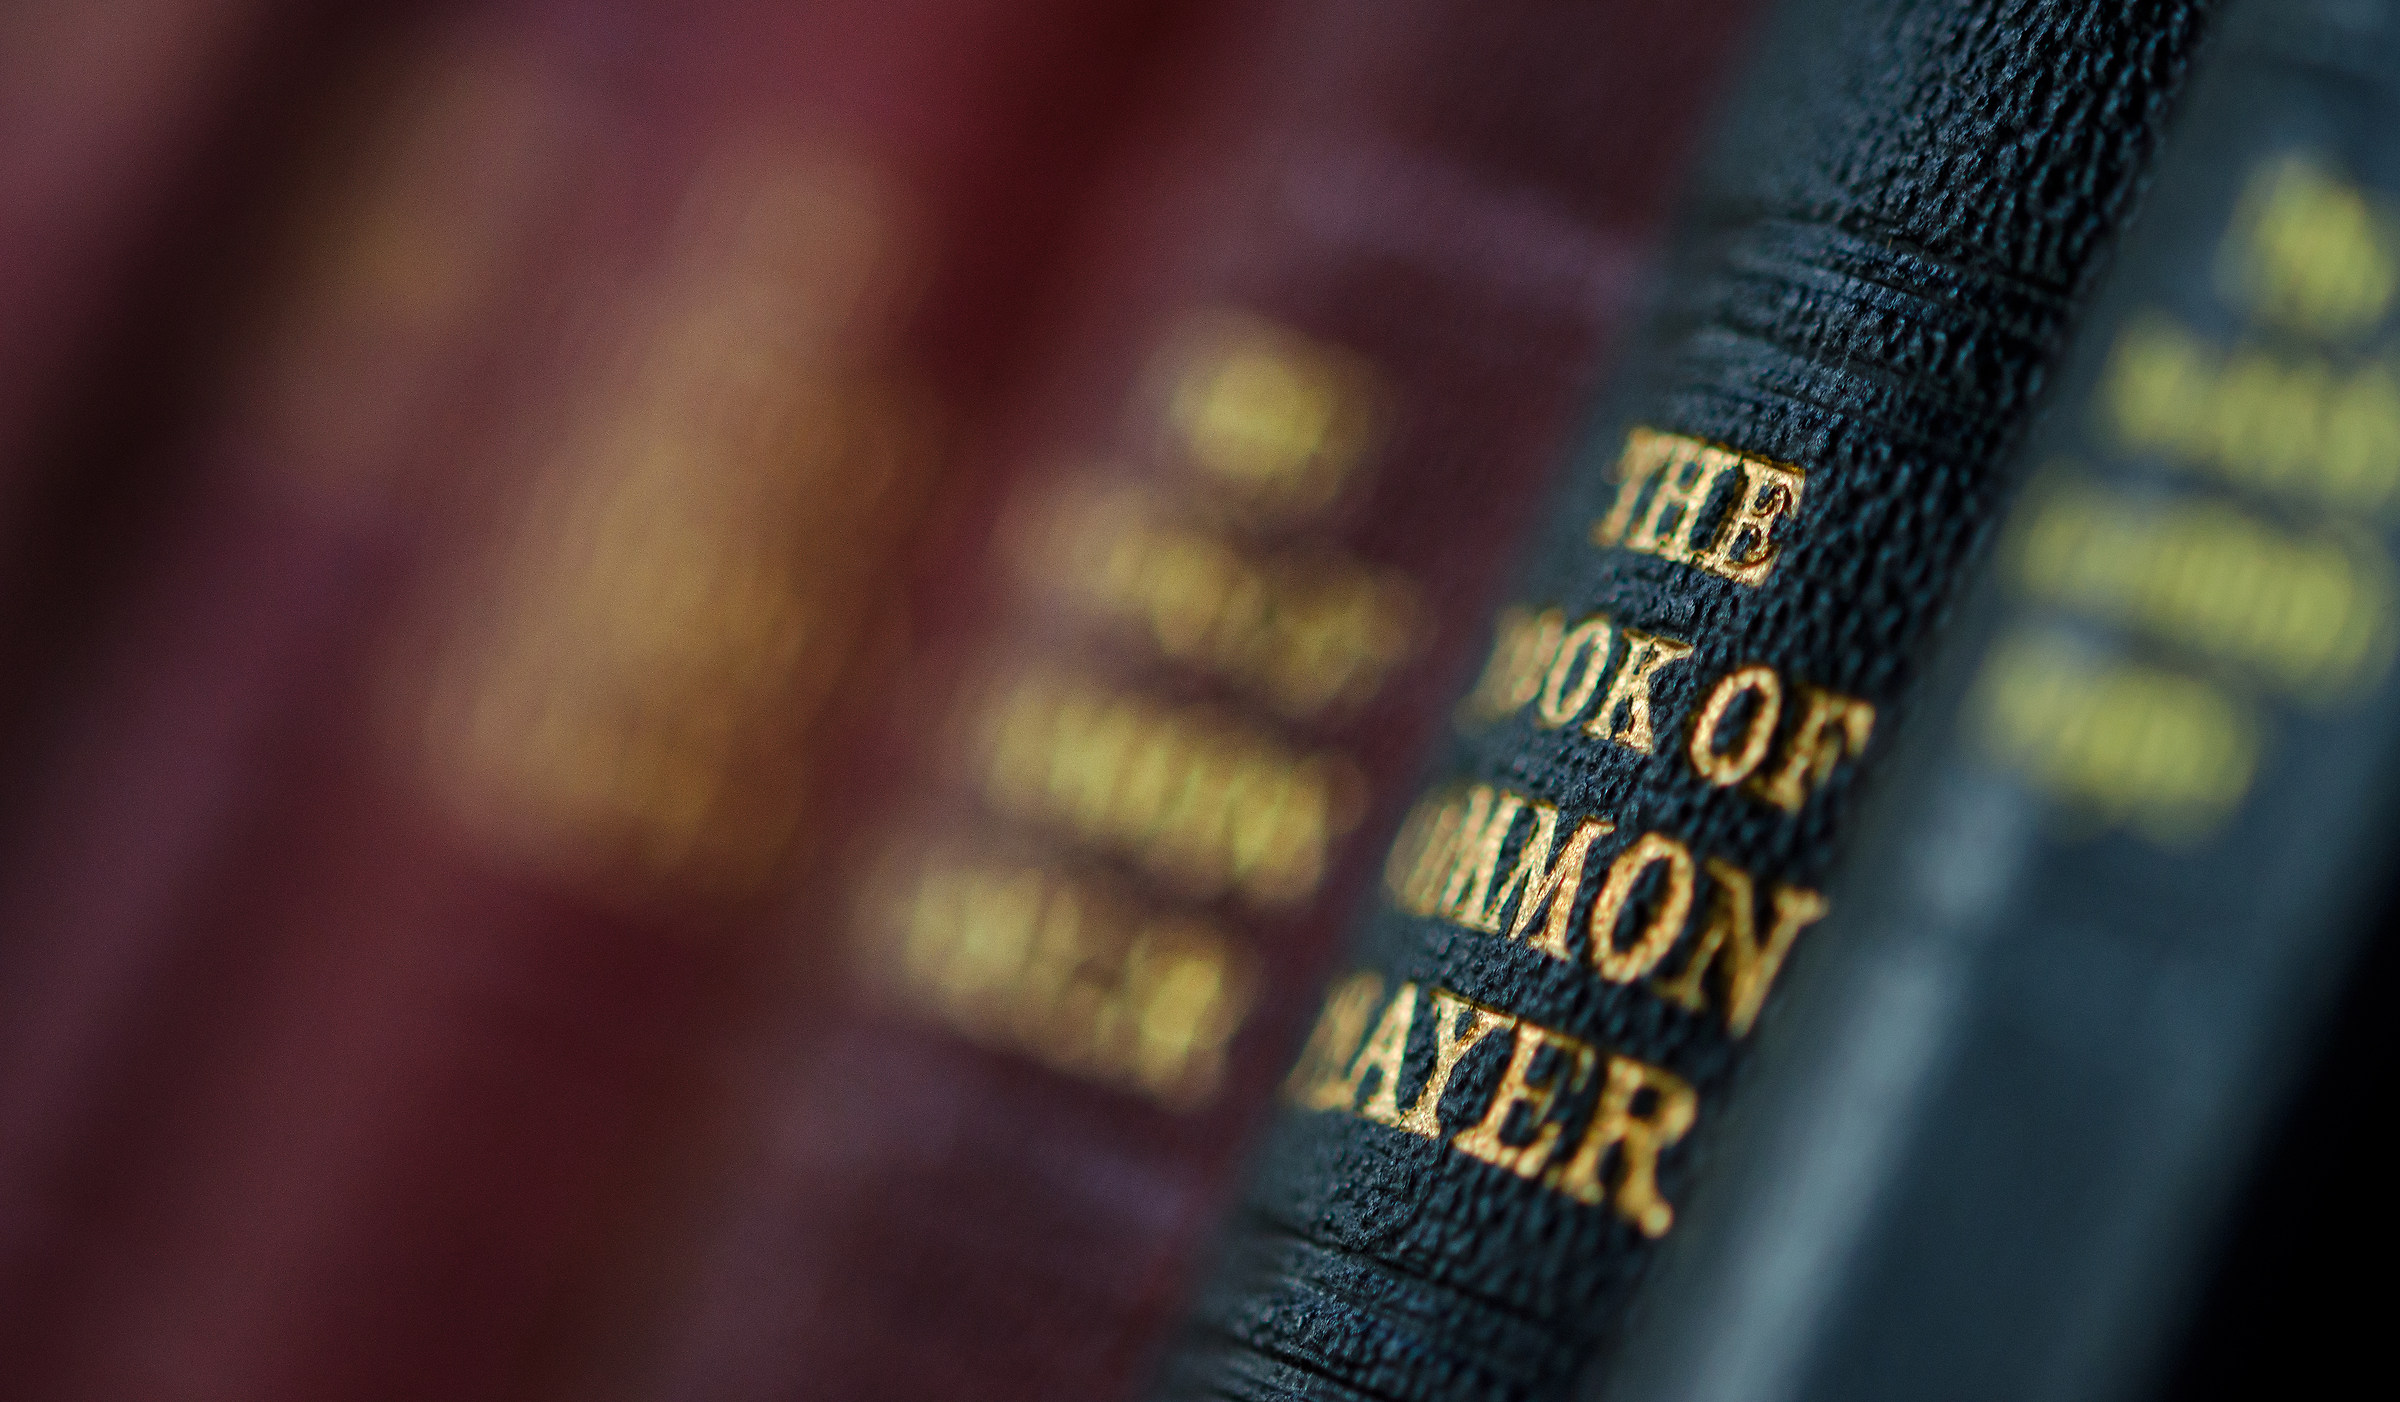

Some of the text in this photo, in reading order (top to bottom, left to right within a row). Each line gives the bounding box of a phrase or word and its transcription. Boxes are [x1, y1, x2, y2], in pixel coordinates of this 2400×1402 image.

[1592, 426, 1806, 587] THE
[1455, 606, 1694, 755] OK
[1688, 665, 1877, 815] OF
[1385, 782, 1829, 1040] MMON
[1280, 968, 1699, 1240] AYER
